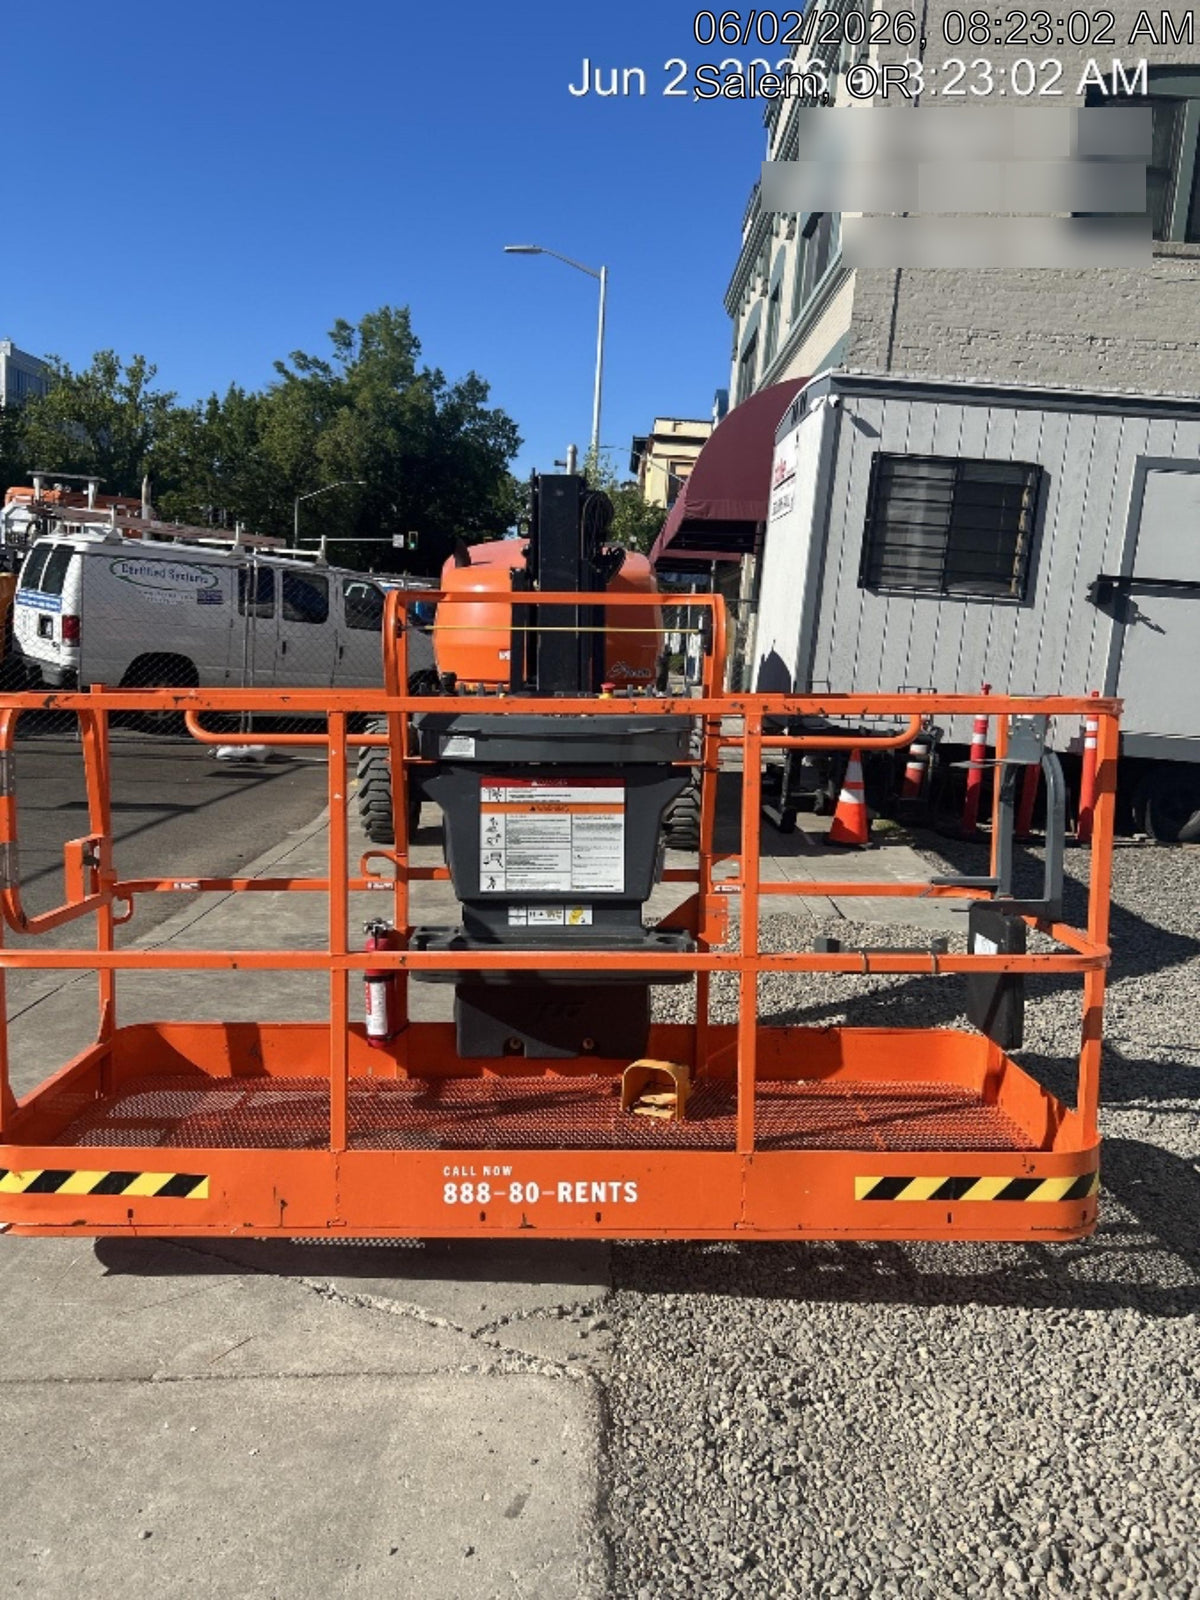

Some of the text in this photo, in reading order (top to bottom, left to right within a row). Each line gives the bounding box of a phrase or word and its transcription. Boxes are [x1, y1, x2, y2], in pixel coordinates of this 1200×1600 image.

[443, 1166, 513, 1176] CALL NOW
[443, 1181, 639, 1204] 888-80-RENTS
